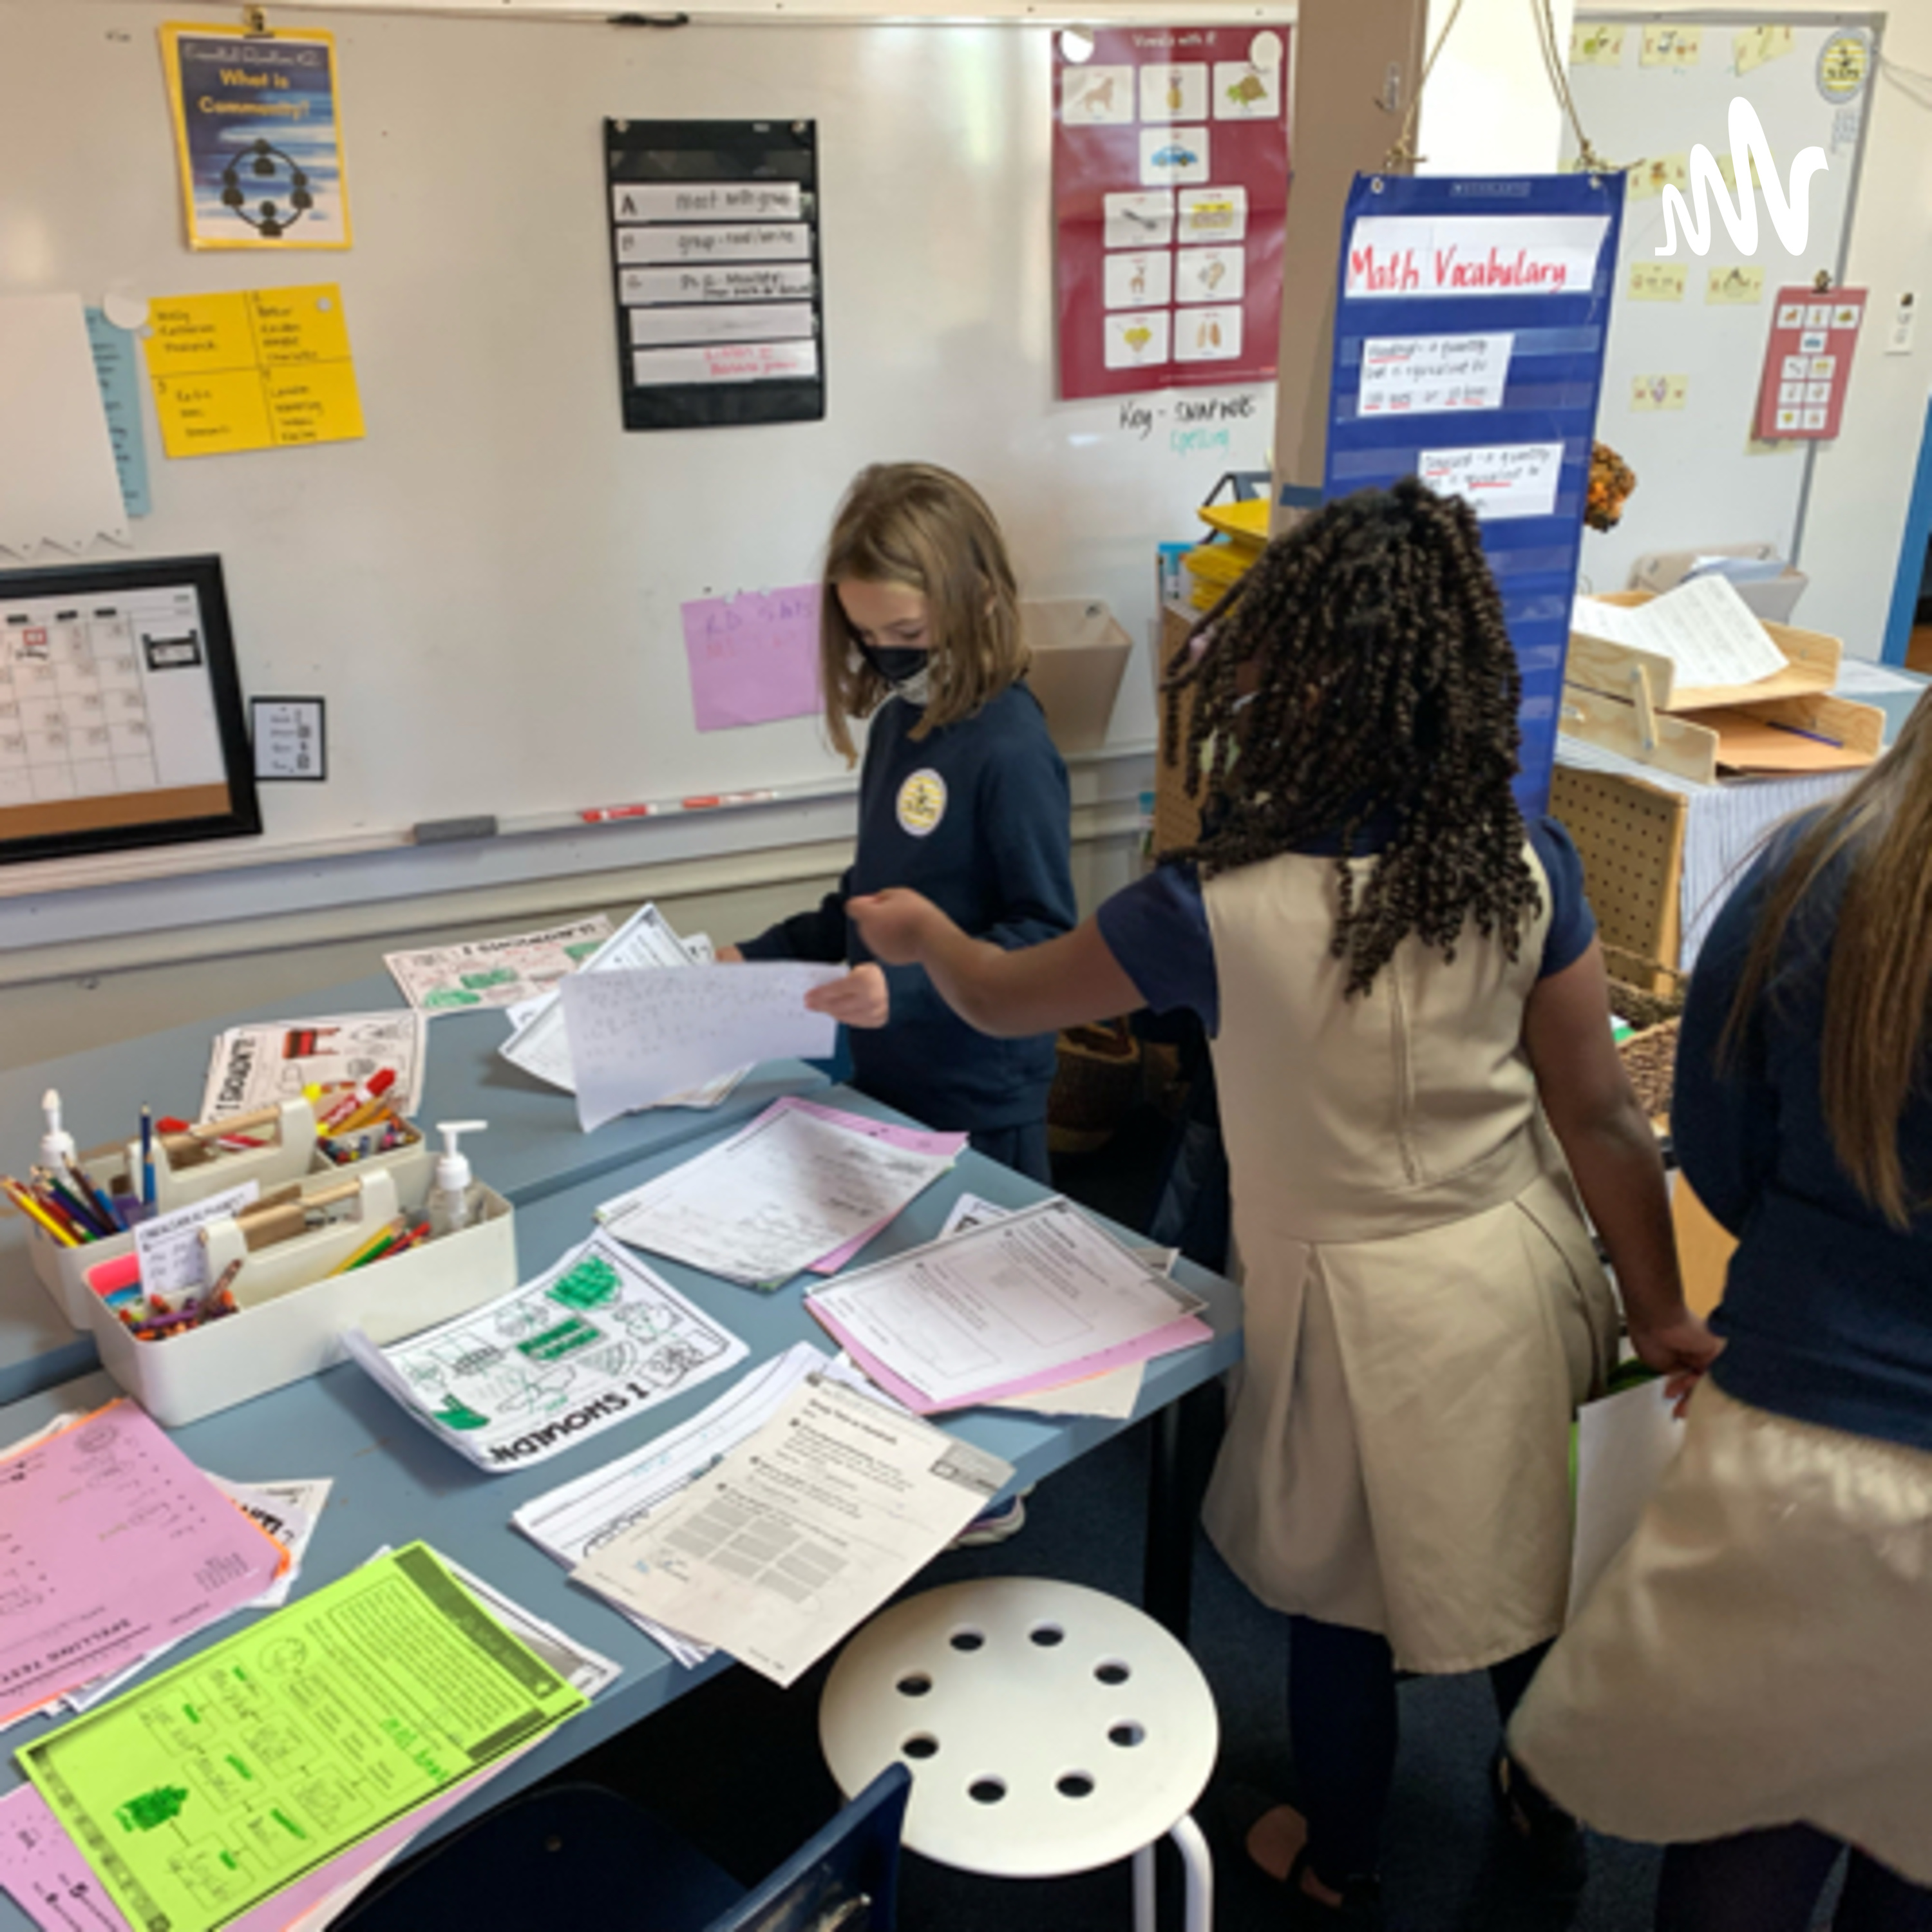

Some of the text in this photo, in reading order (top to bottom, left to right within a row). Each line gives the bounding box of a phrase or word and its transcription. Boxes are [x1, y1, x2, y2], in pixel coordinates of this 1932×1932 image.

[219, 68, 290, 89] What is
[198, 96, 310, 121] Community?
[621, 194, 637, 215] A
[1349, 243, 1567, 294] Math Vocabulary
[1120, 399, 1153, 440] Key
[623, 1381, 650, 1401] I
[46, 1617, 133, 1664] SPELLING
